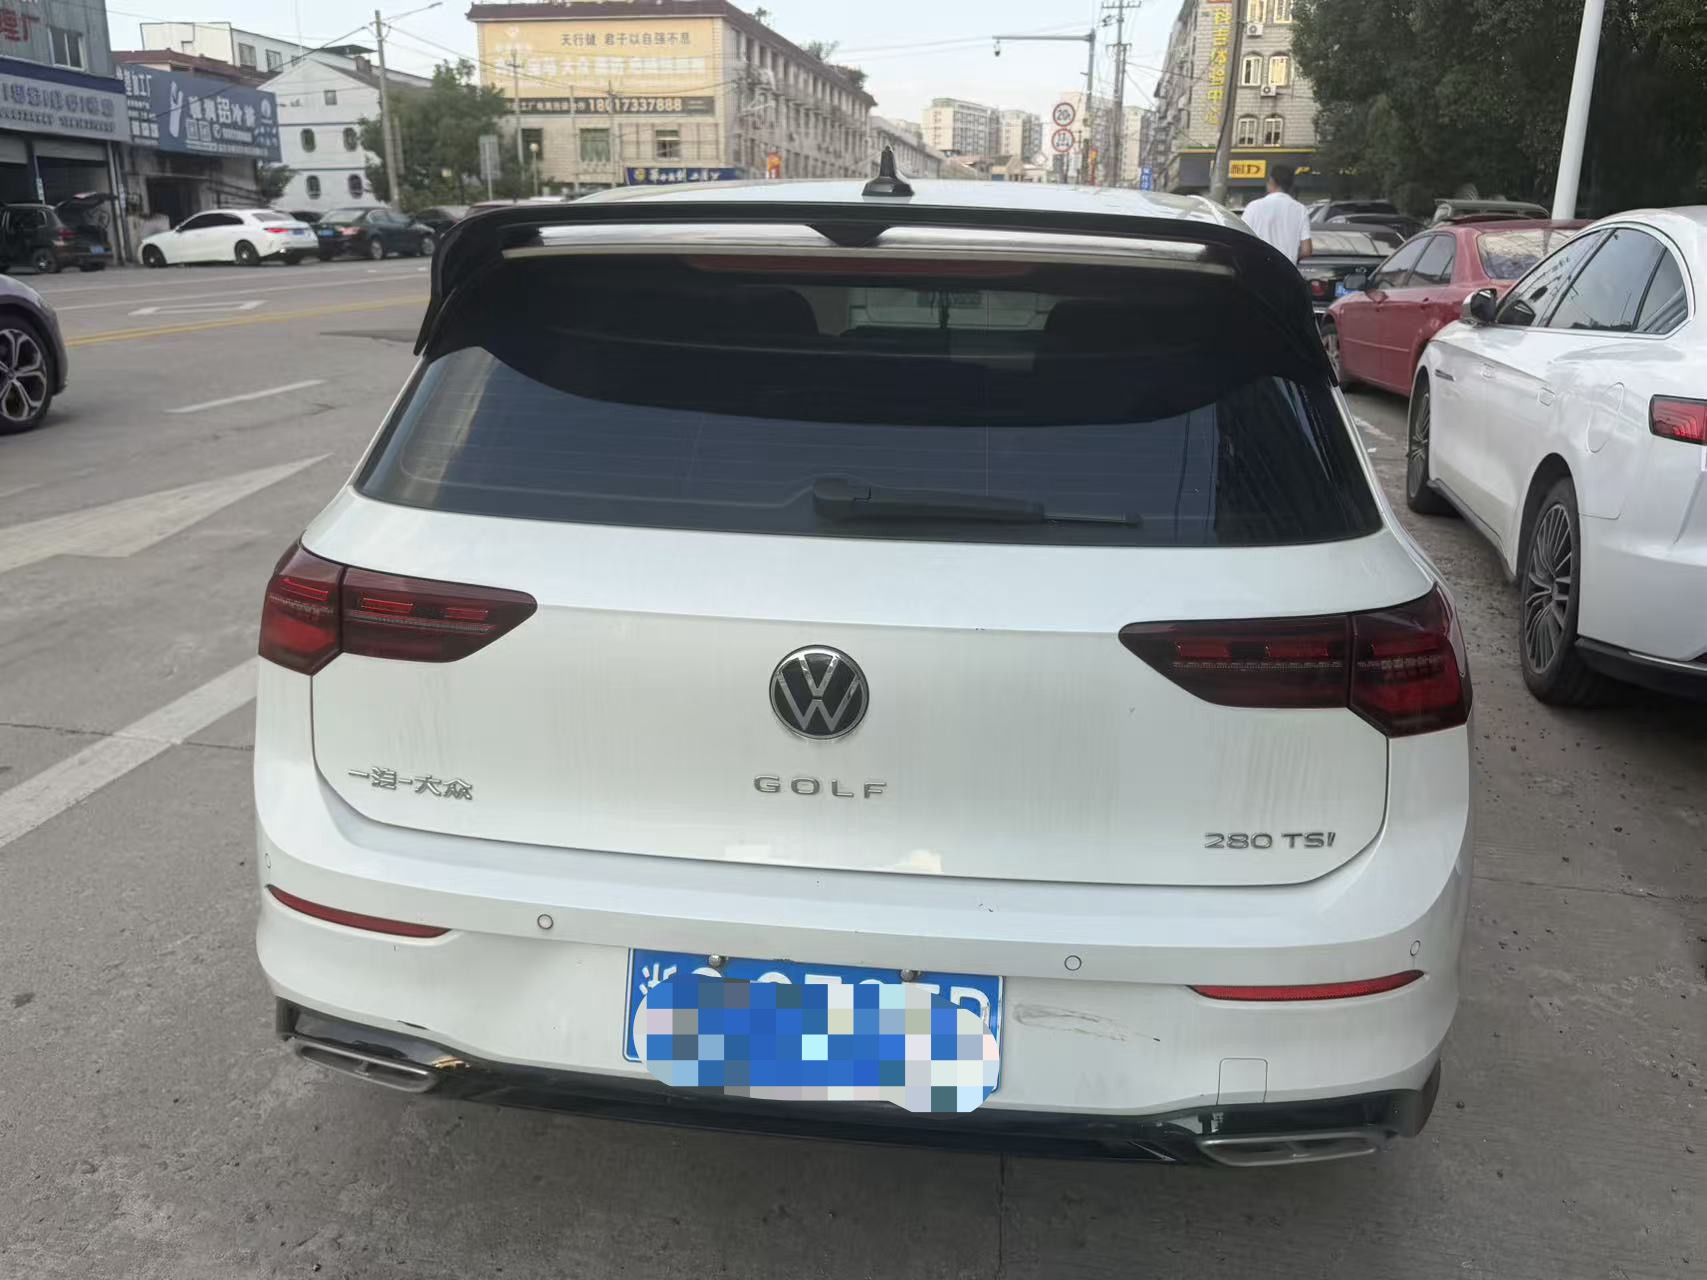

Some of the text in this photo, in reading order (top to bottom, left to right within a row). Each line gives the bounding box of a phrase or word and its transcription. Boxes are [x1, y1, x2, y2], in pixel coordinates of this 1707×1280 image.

[774, 649, 864, 735] VW
[754, 775, 887, 799] GOLF
[1204, 832, 1273, 849] 280
